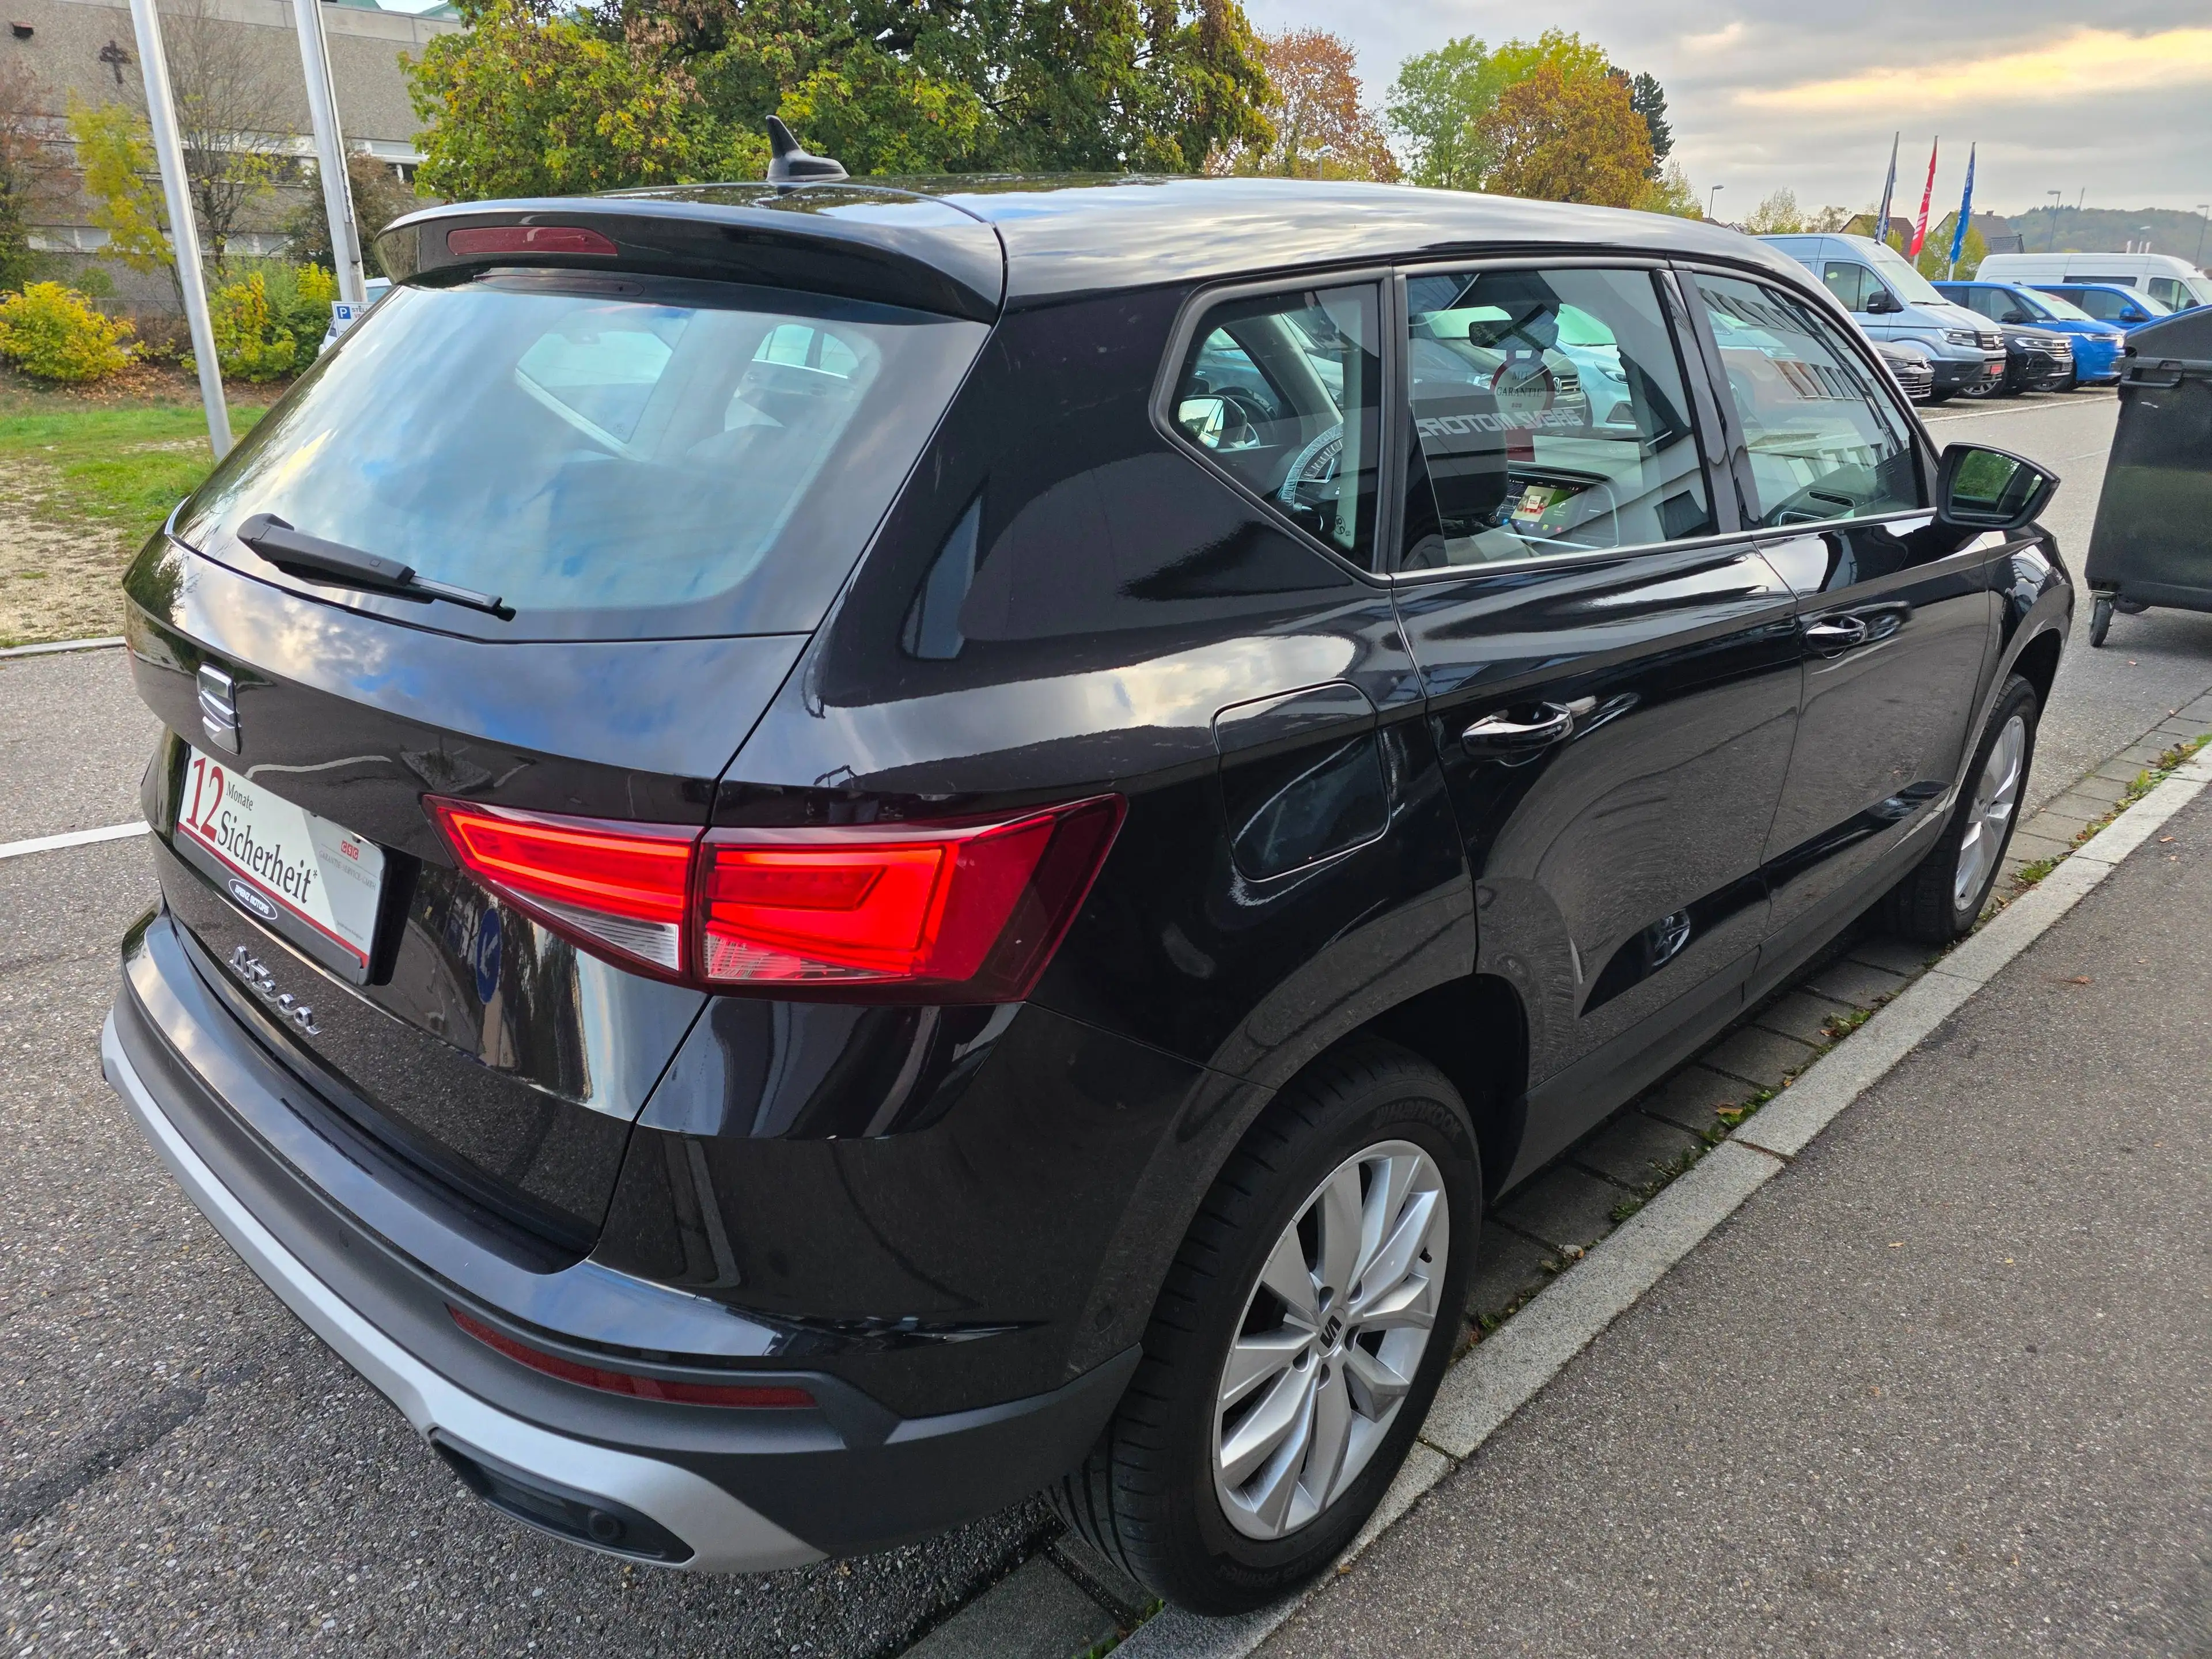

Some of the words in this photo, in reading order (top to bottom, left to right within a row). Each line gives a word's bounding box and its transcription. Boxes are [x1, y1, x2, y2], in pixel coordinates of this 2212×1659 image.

[186, 757, 224, 843] 12
[226, 781, 253, 811] Monate
[342, 842, 358, 859] GSG
[250, 895, 269, 915] MOTORS
